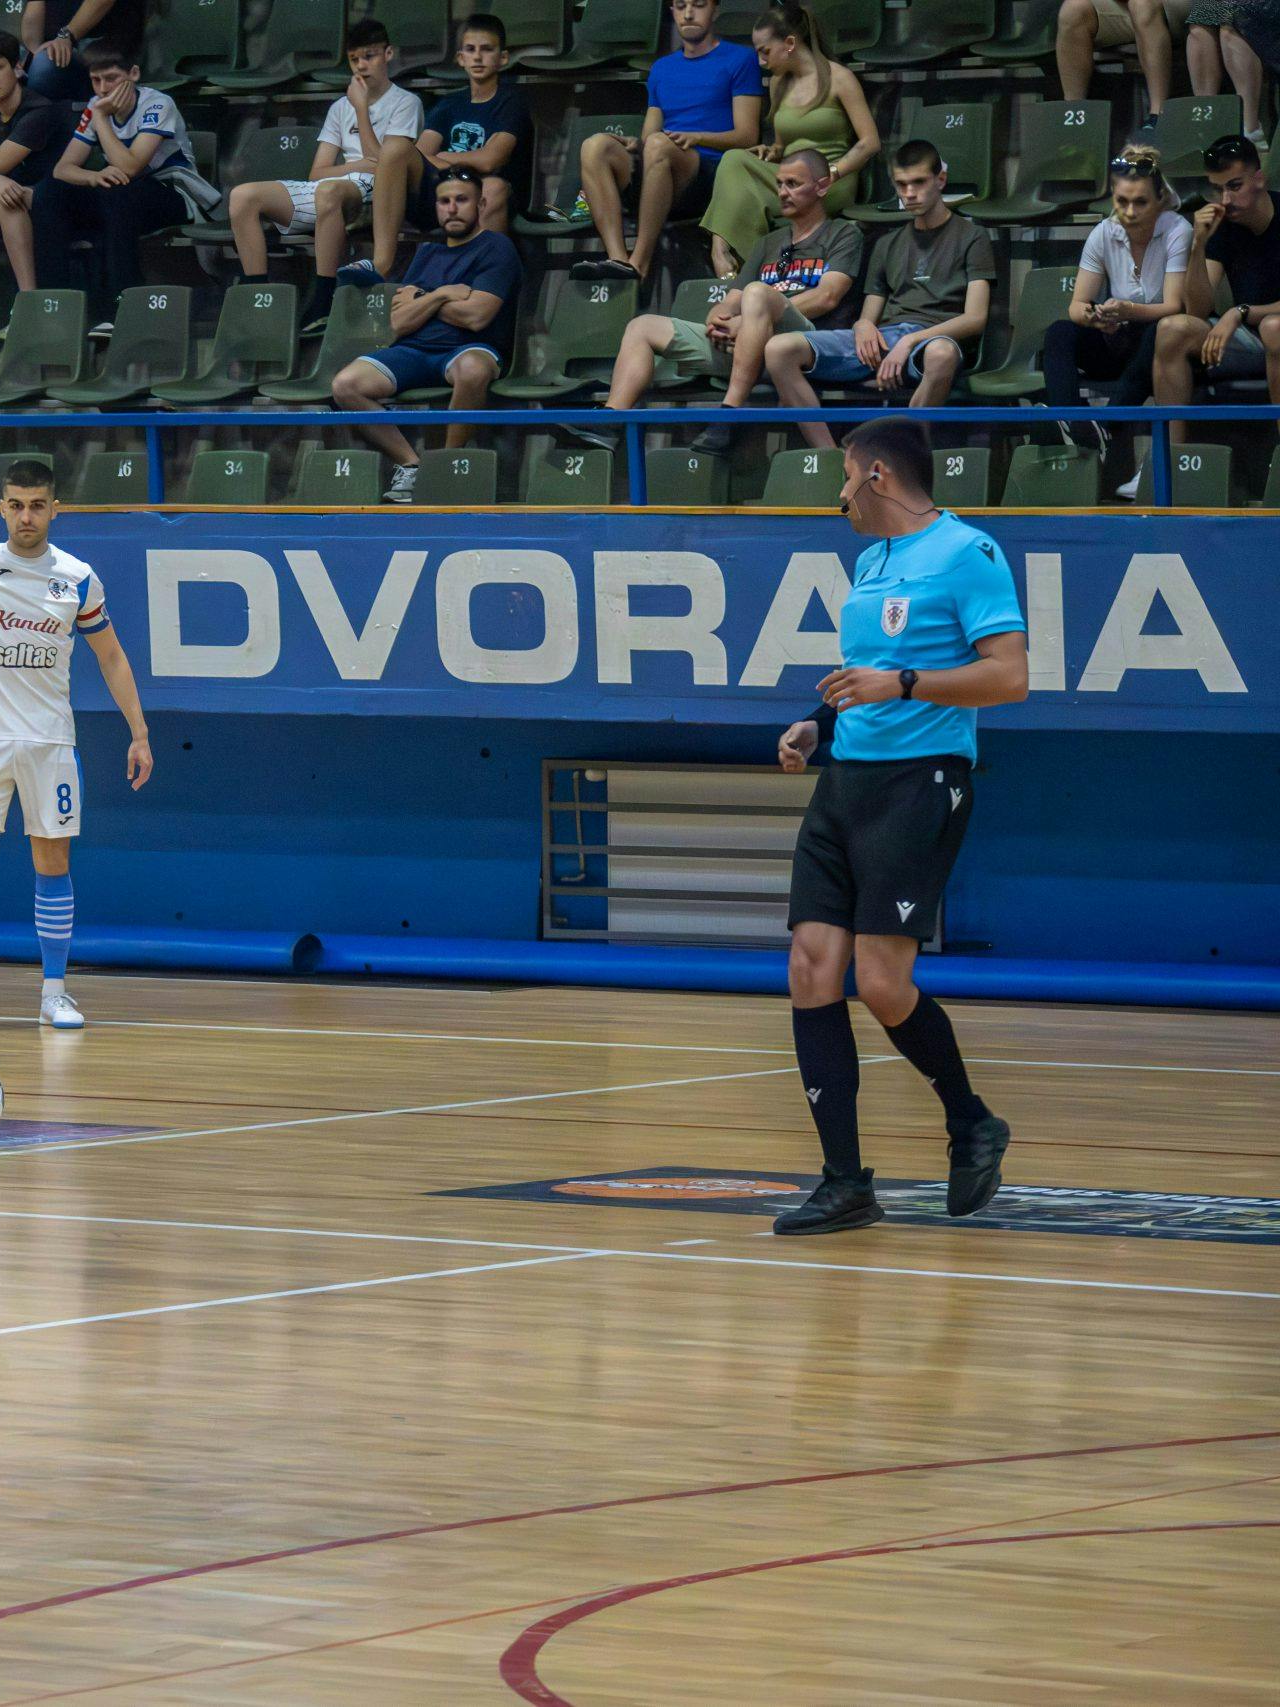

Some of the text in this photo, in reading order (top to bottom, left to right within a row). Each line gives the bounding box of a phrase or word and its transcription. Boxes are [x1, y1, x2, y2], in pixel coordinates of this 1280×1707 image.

[945, 113, 965, 128] 24
[1064, 110, 1086, 126] 23
[280, 136, 299, 150] 30
[148, 294, 167, 309] 36
[254, 293, 273, 308] 29
[590, 285, 609, 303] 26
[707, 285, 728, 303] 25
[334, 458, 350, 476] 14
[564, 456, 584, 476] 27
[803, 455, 819, 474] 21
[945, 456, 964, 476] 23
[1178, 455, 1202, 471] 30
[56, 783, 72, 815] 8
